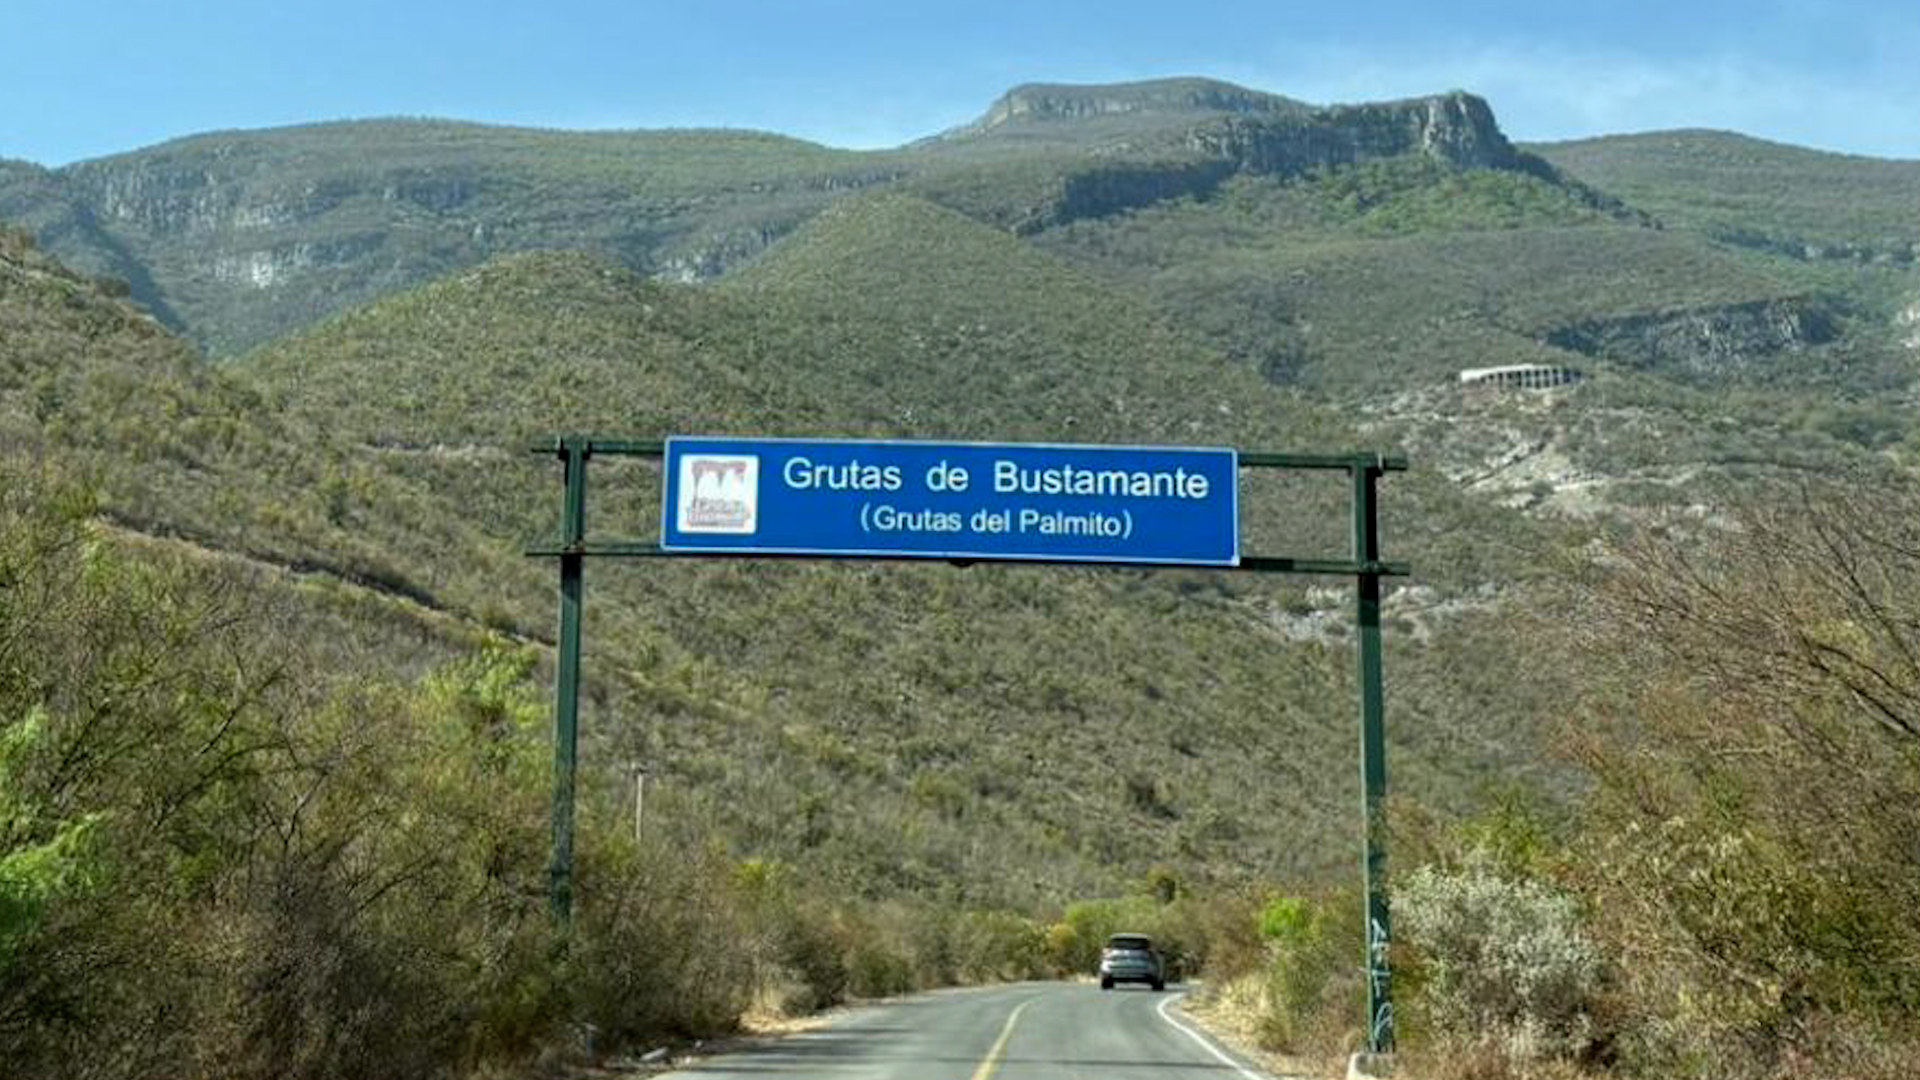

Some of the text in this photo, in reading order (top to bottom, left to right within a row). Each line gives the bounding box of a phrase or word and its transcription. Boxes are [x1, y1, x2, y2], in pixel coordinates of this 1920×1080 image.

[783, 456, 1210, 499] Grutas de Bustamante
[860, 502, 1133, 540] (Grutas del Palmito)
